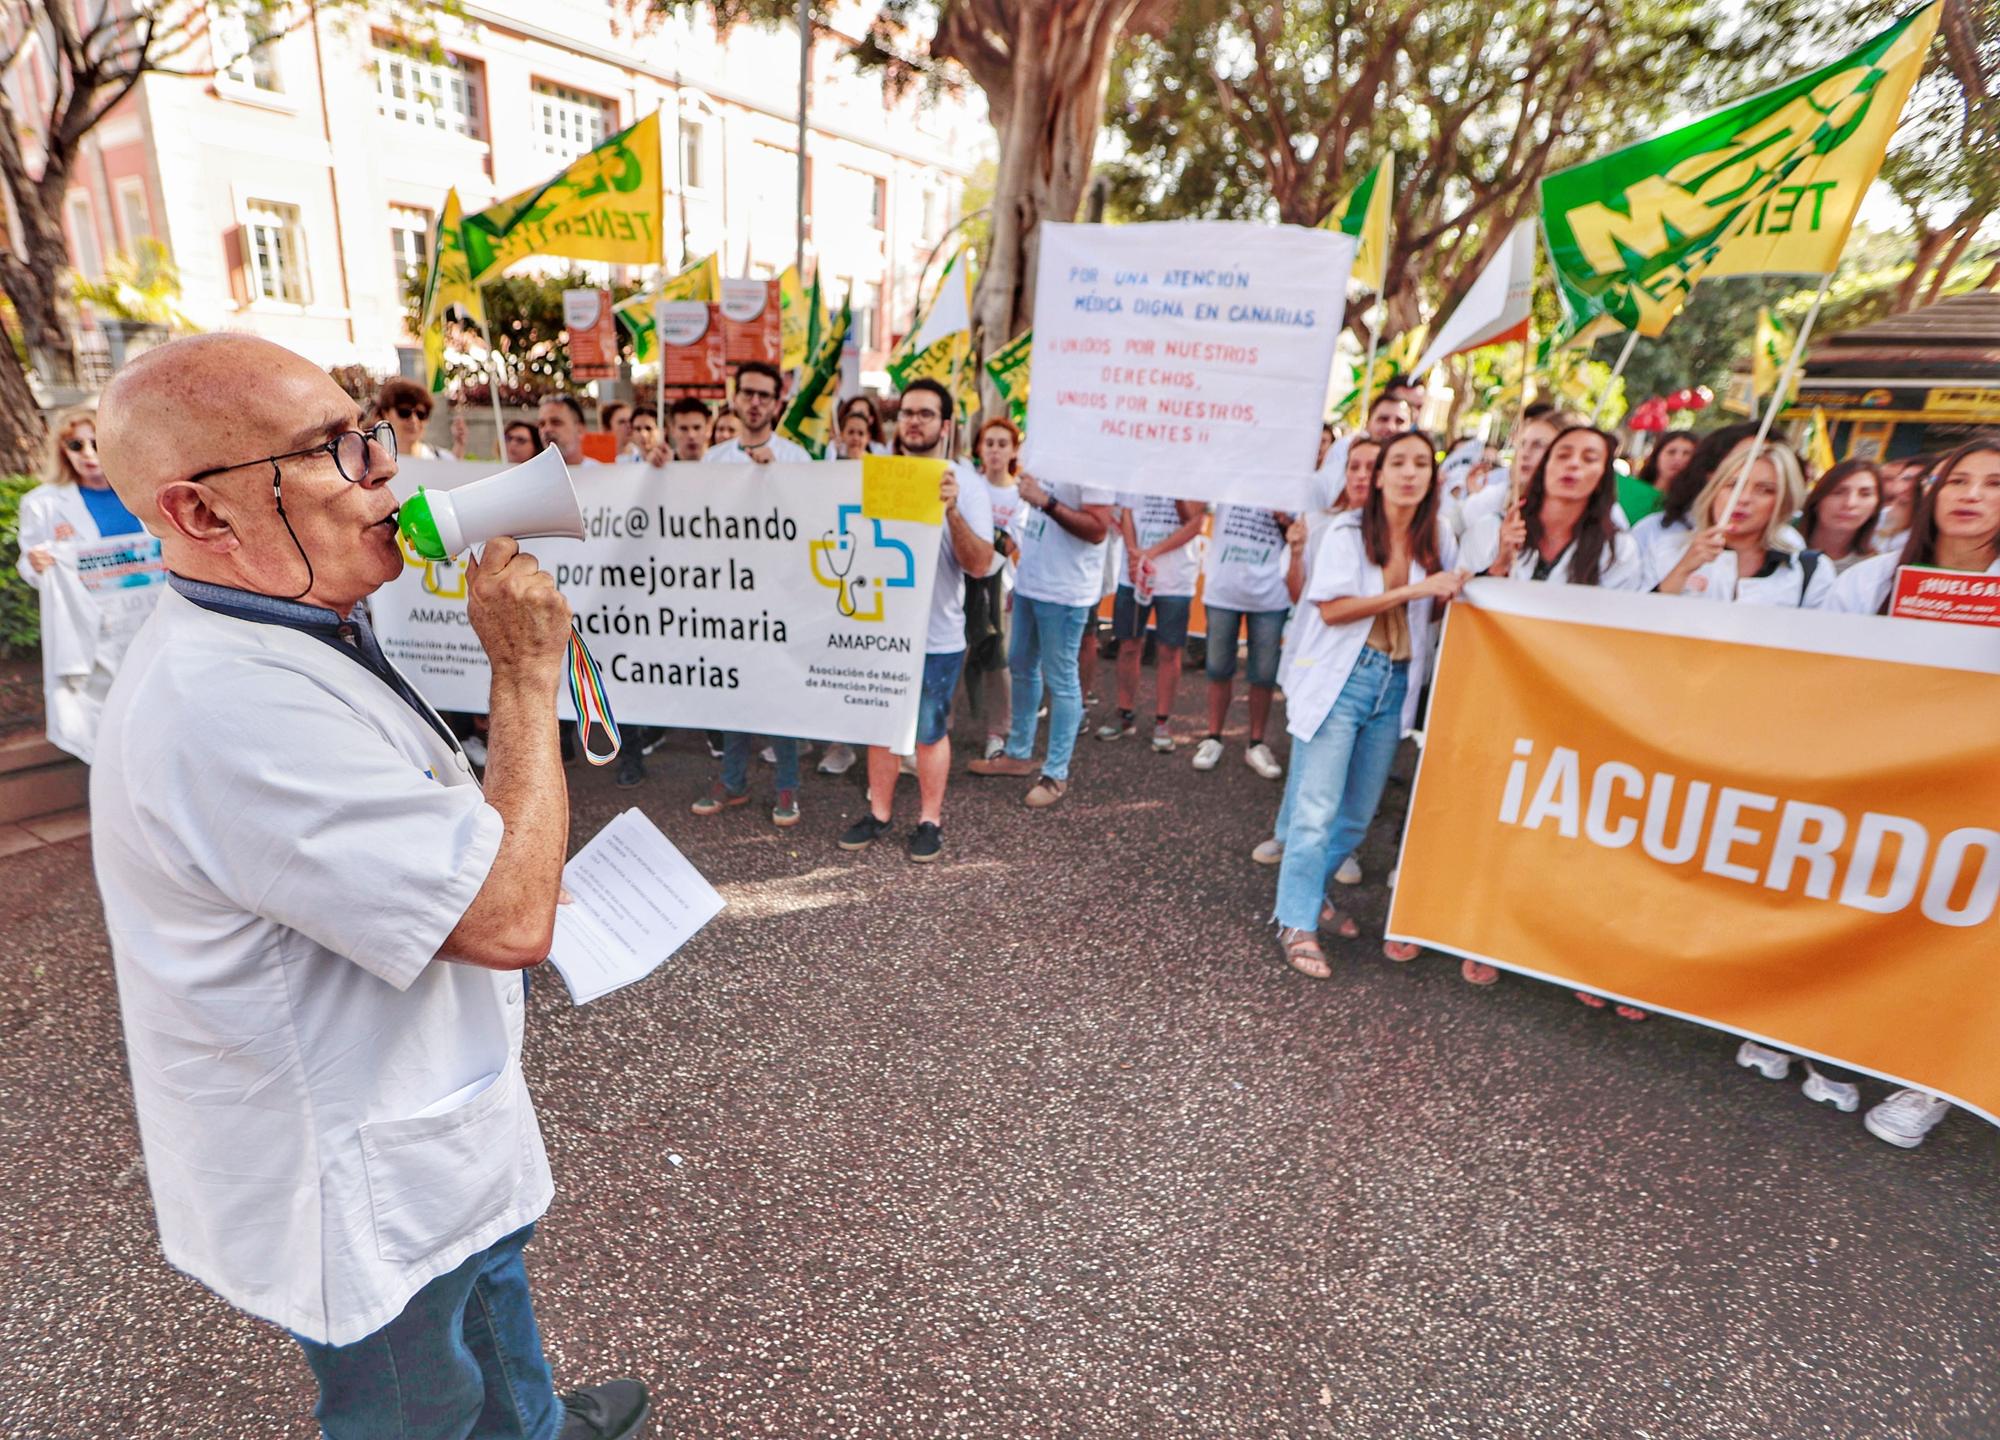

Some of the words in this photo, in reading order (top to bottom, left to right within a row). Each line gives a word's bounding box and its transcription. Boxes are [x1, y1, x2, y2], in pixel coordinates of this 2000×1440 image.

[1069, 266, 1099, 283] POR
[1114, 269, 1149, 285] UNA
[1162, 262, 1250, 288] ATENCIÓN
[1074, 289, 1123, 313] MÉDICA
[1133, 299, 1185, 318] DIGNA
[1194, 303, 1219, 321] EN
[1228, 304, 1316, 327] CANARIAS
[1124, 338, 1155, 356] POR
[1165, 340, 1258, 366] NUESTROS
[1056, 390, 1108, 410] UNIDOS
[1115, 394, 1147, 412] POR
[658, 505, 798, 541] luchando
[556, 563, 594, 590] por
[600, 556, 722, 595] mejorar
[729, 558, 755, 591] la
[408, 607, 469, 626] AMAPC
[658, 607, 788, 643] Primaria
[827, 633, 911, 653] AMAPCAN
[611, 653, 740, 689] Canarias
[808, 664, 865, 679] Asociación
[866, 669, 879, 679] de
[805, 678, 818, 688] de
[820, 679, 867, 692] Atención
[843, 694, 890, 708] Canarias
[1498, 737, 2000, 928] ¡ACUERDO
